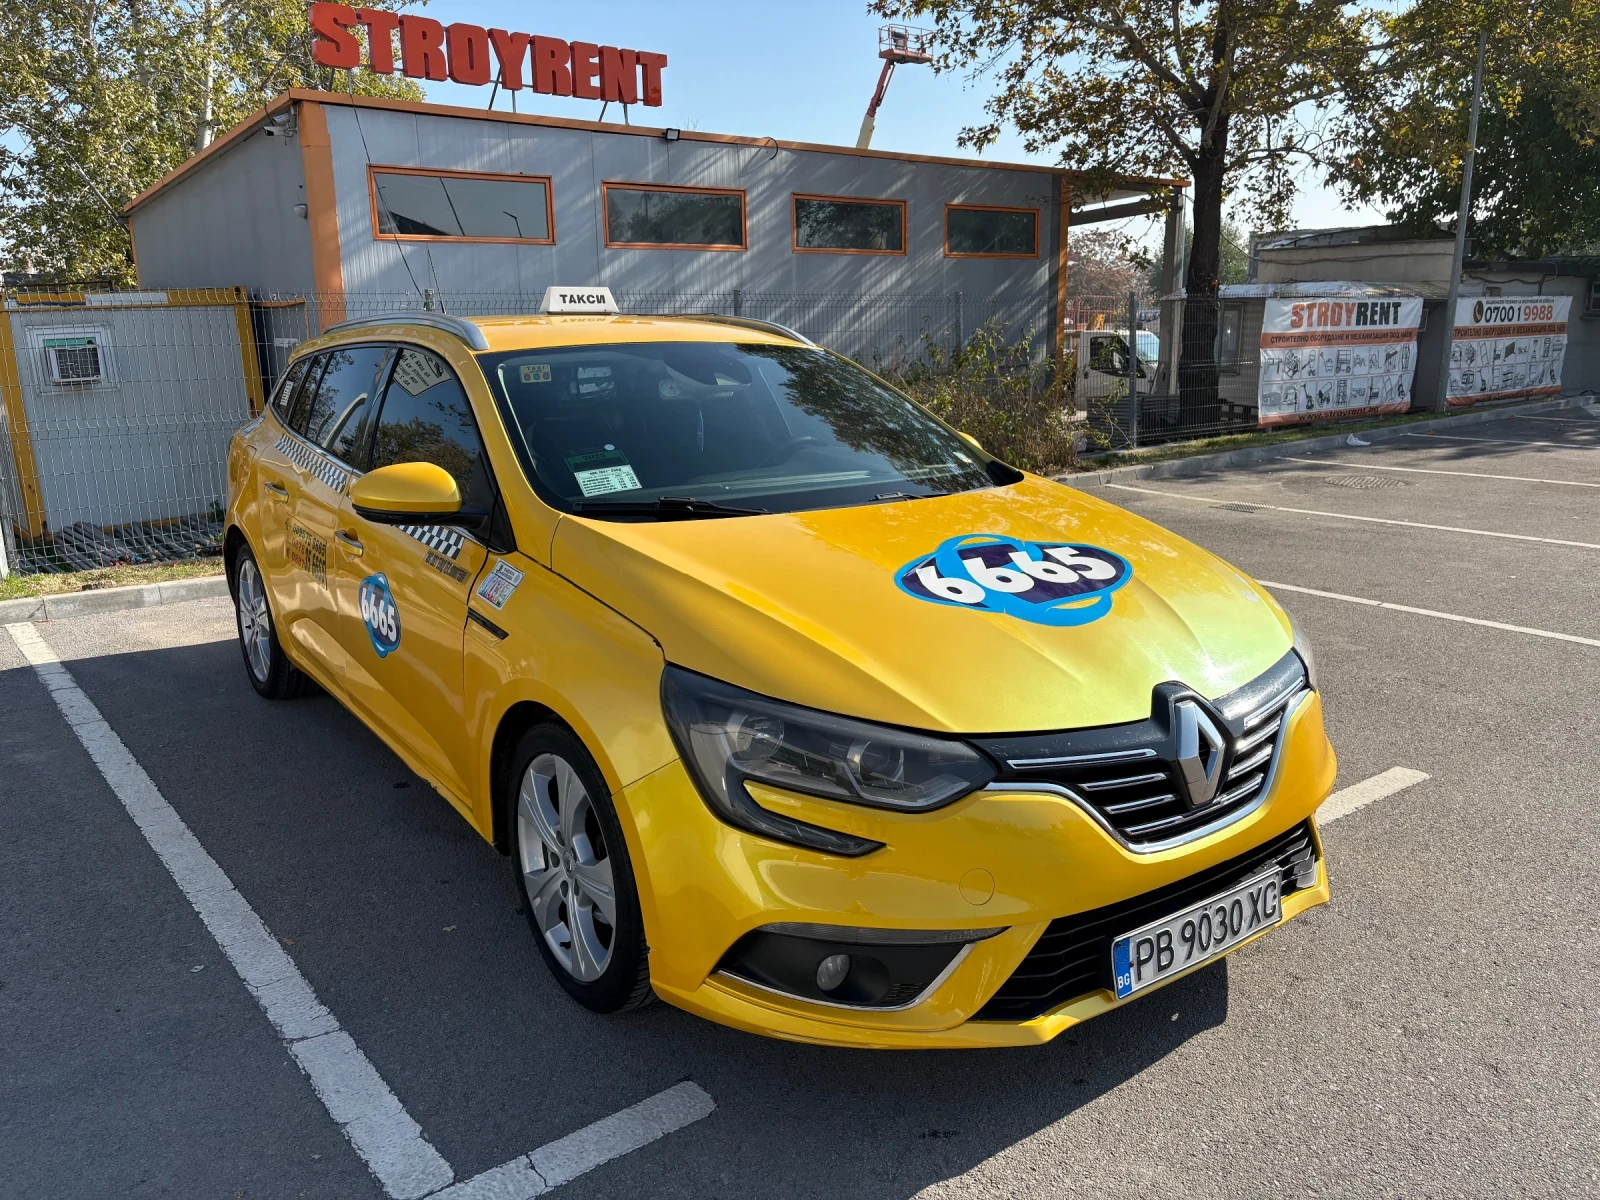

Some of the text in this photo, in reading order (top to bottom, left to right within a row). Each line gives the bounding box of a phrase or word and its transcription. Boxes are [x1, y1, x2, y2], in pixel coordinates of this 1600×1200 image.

[309, 3, 667, 107] STROYRENT
[559, 294, 606, 304] ТАКСИ
[1290, 301, 1402, 328] STROYRENT
[1270, 334, 1309, 345] СТРОИТЕЛНО
[1310, 333, 1345, 343] ОБОРУДВАНЕ
[1351, 331, 1389, 341] МЕХАНИЗАЦИЯ
[1454, 327, 1482, 338] ТРОИТЕЛНО
[1298, 406, 1380, 420] www.stroyrent.bg
[915, 546, 1117, 604] 6665
[361, 586, 397, 642] 6665
[1136, 929, 1175, 982] PB
[1181, 898, 1244, 962] 9030
[1117, 973, 1130, 990] BG
